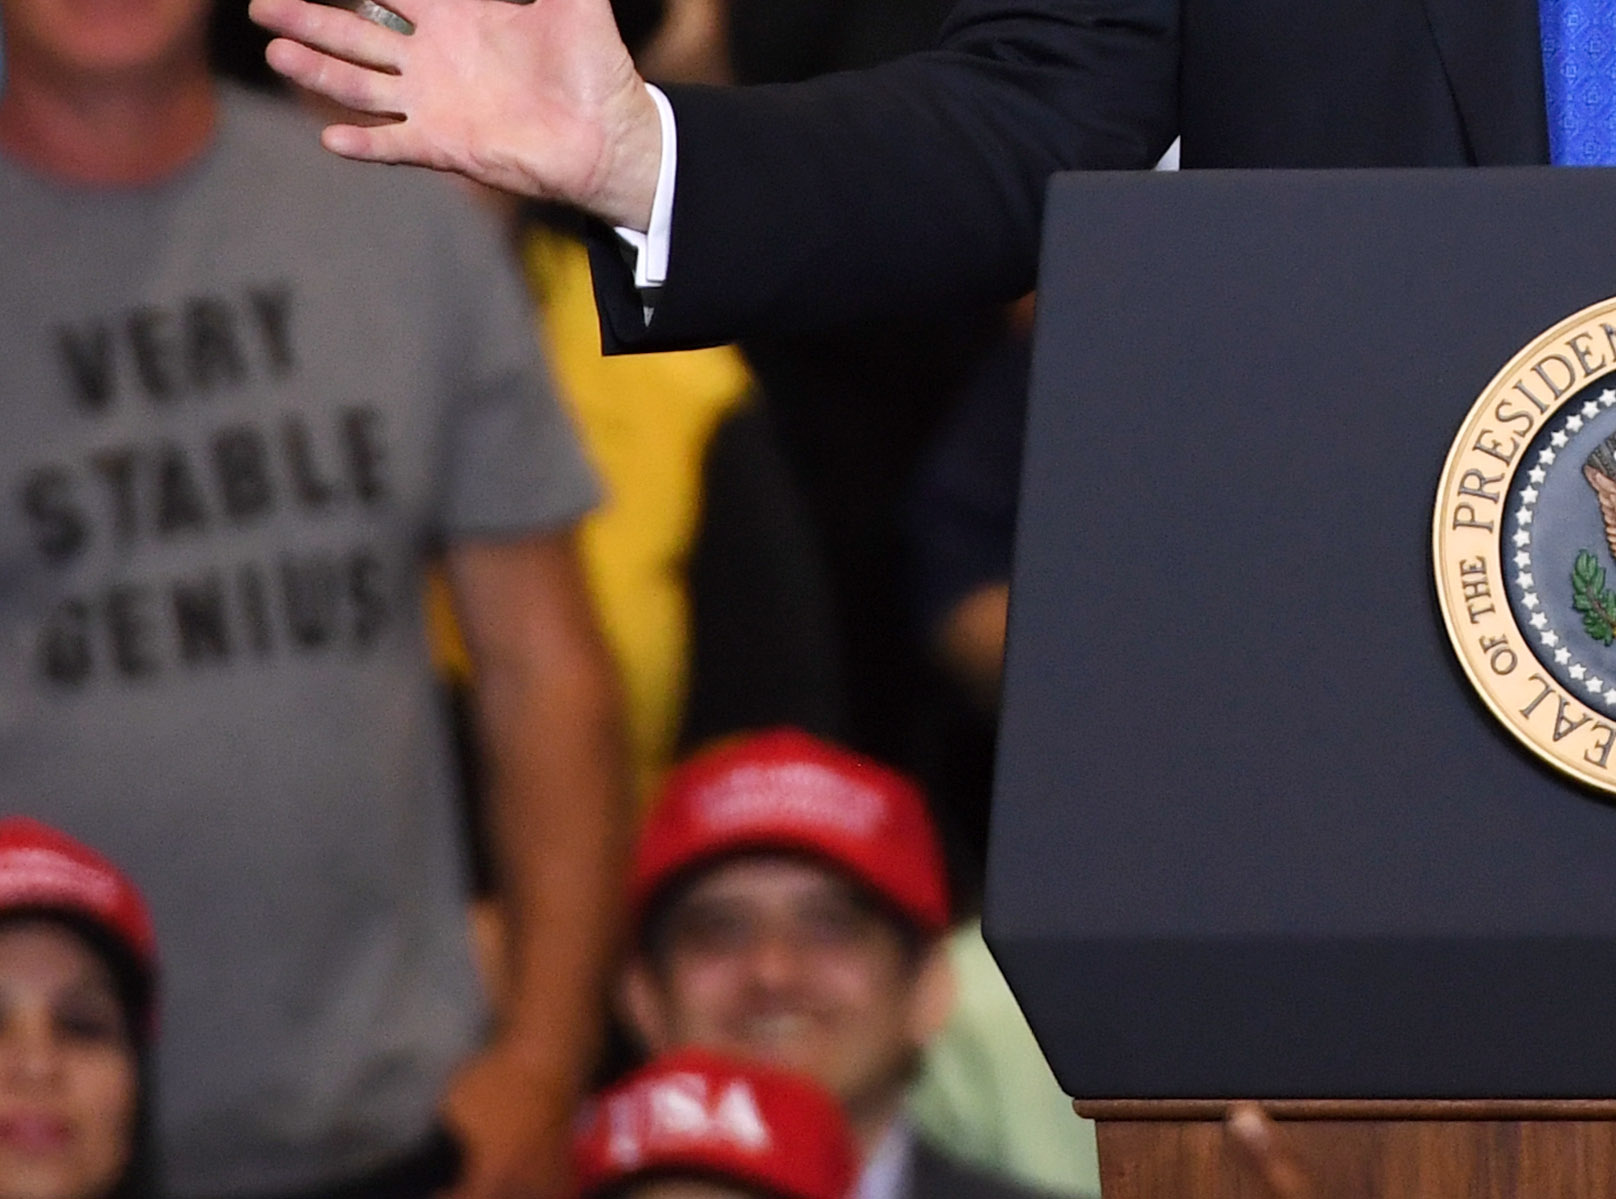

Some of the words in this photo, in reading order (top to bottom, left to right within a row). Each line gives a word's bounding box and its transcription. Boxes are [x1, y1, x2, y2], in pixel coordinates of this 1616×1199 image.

[54, 283, 294, 412] VERY
[20, 406, 386, 564] STABLE
[40, 553, 389, 687] GENIUS
[1458, 555, 1496, 622] THE
[1482, 634, 1518, 676] OF
